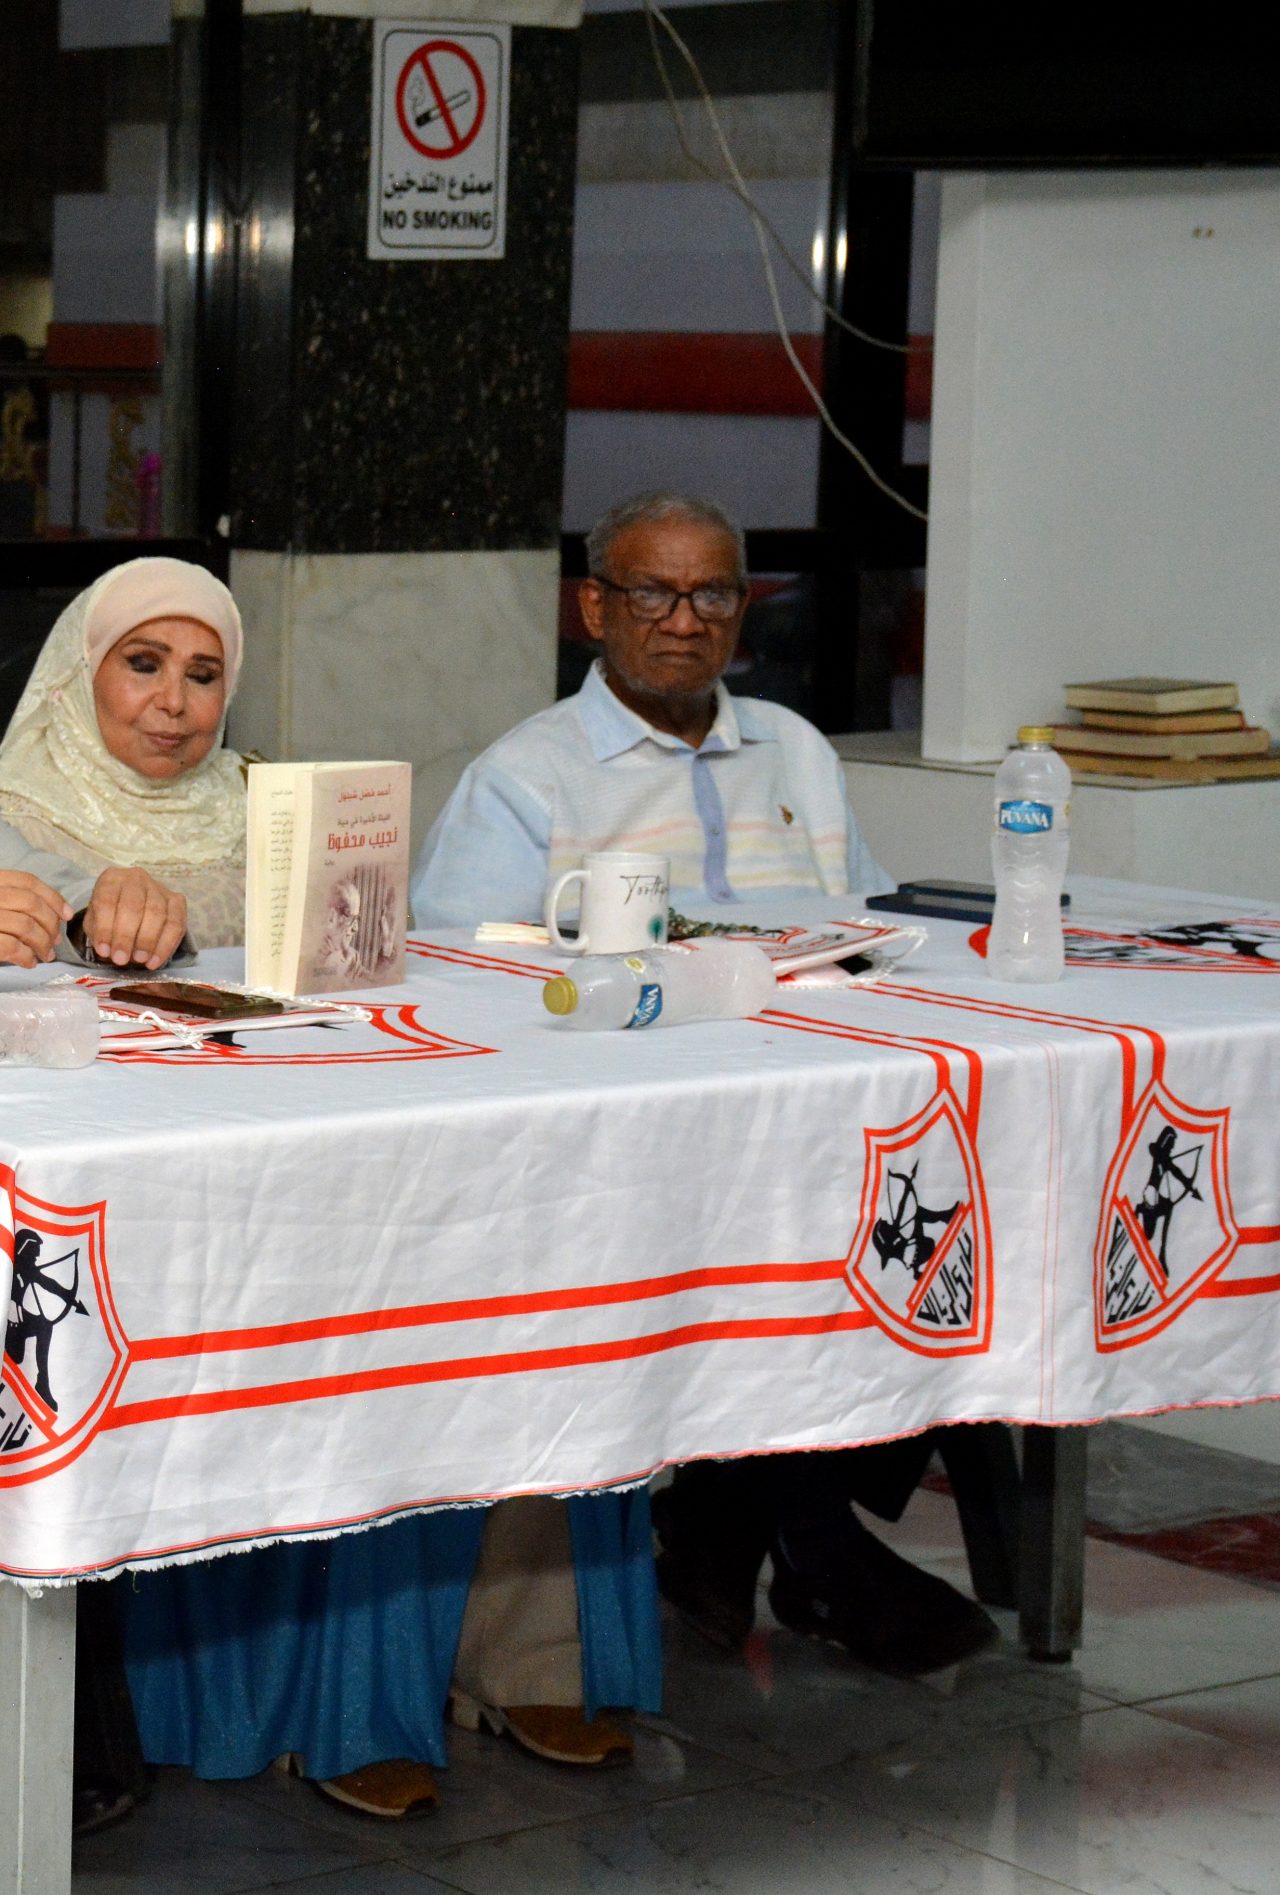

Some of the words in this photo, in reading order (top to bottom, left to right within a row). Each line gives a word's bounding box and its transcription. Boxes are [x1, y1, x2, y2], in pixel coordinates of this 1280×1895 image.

[383, 171, 445, 199] التدخين
[447, 173, 493, 201] ممنوع
[382, 209, 407, 230] NO
[413, 210, 493, 231] SMOKING
[328, 832, 366, 853] محفوظ
[368, 826, 398, 849] نجيب
